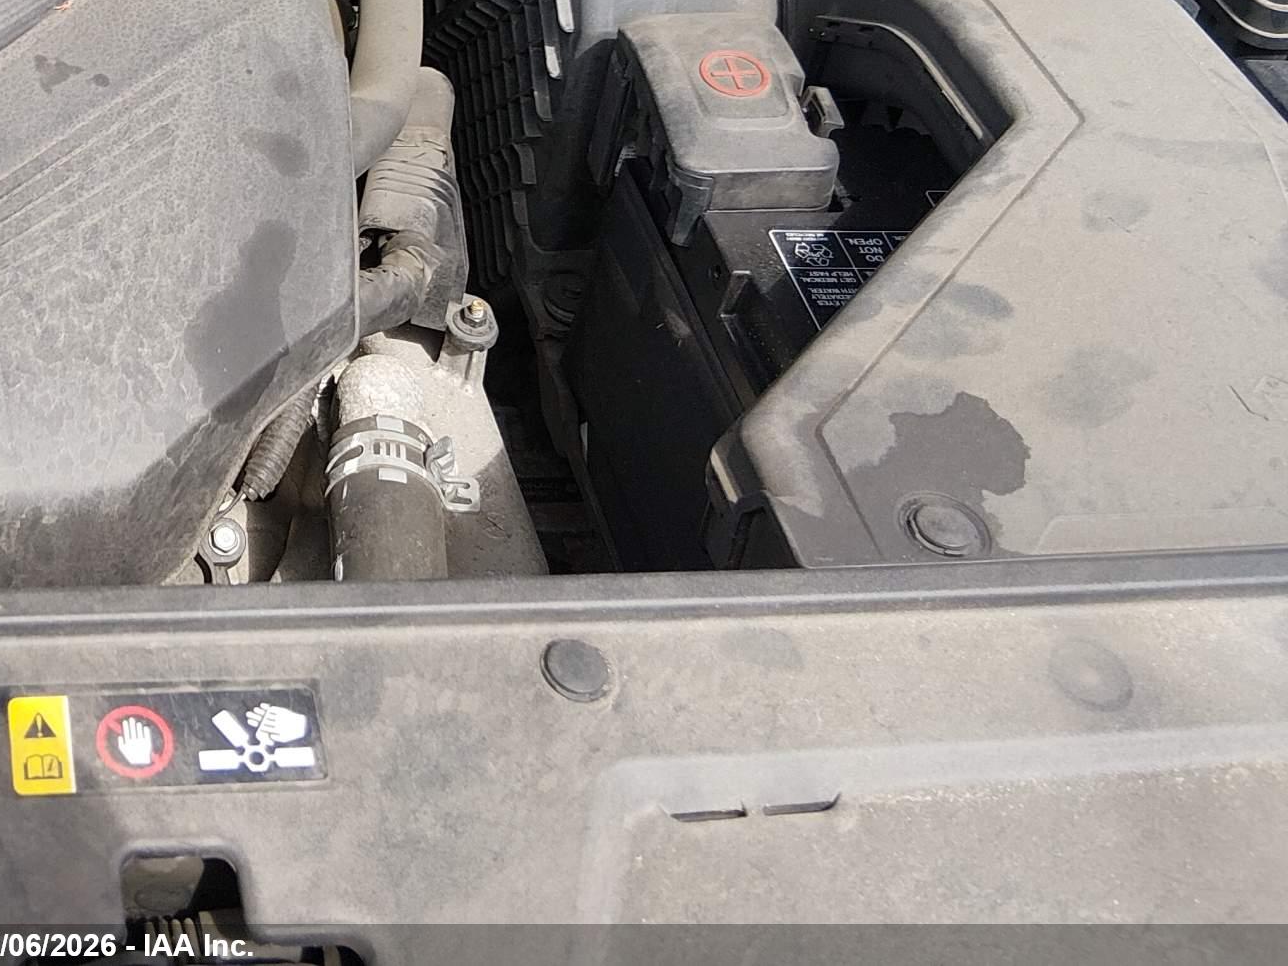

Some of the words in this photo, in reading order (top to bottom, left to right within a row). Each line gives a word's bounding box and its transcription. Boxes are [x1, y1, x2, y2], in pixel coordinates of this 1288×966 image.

[844, 237, 883, 245] OPEN.
[858, 246, 883, 254] NOT
[865, 254, 885, 262] DO
